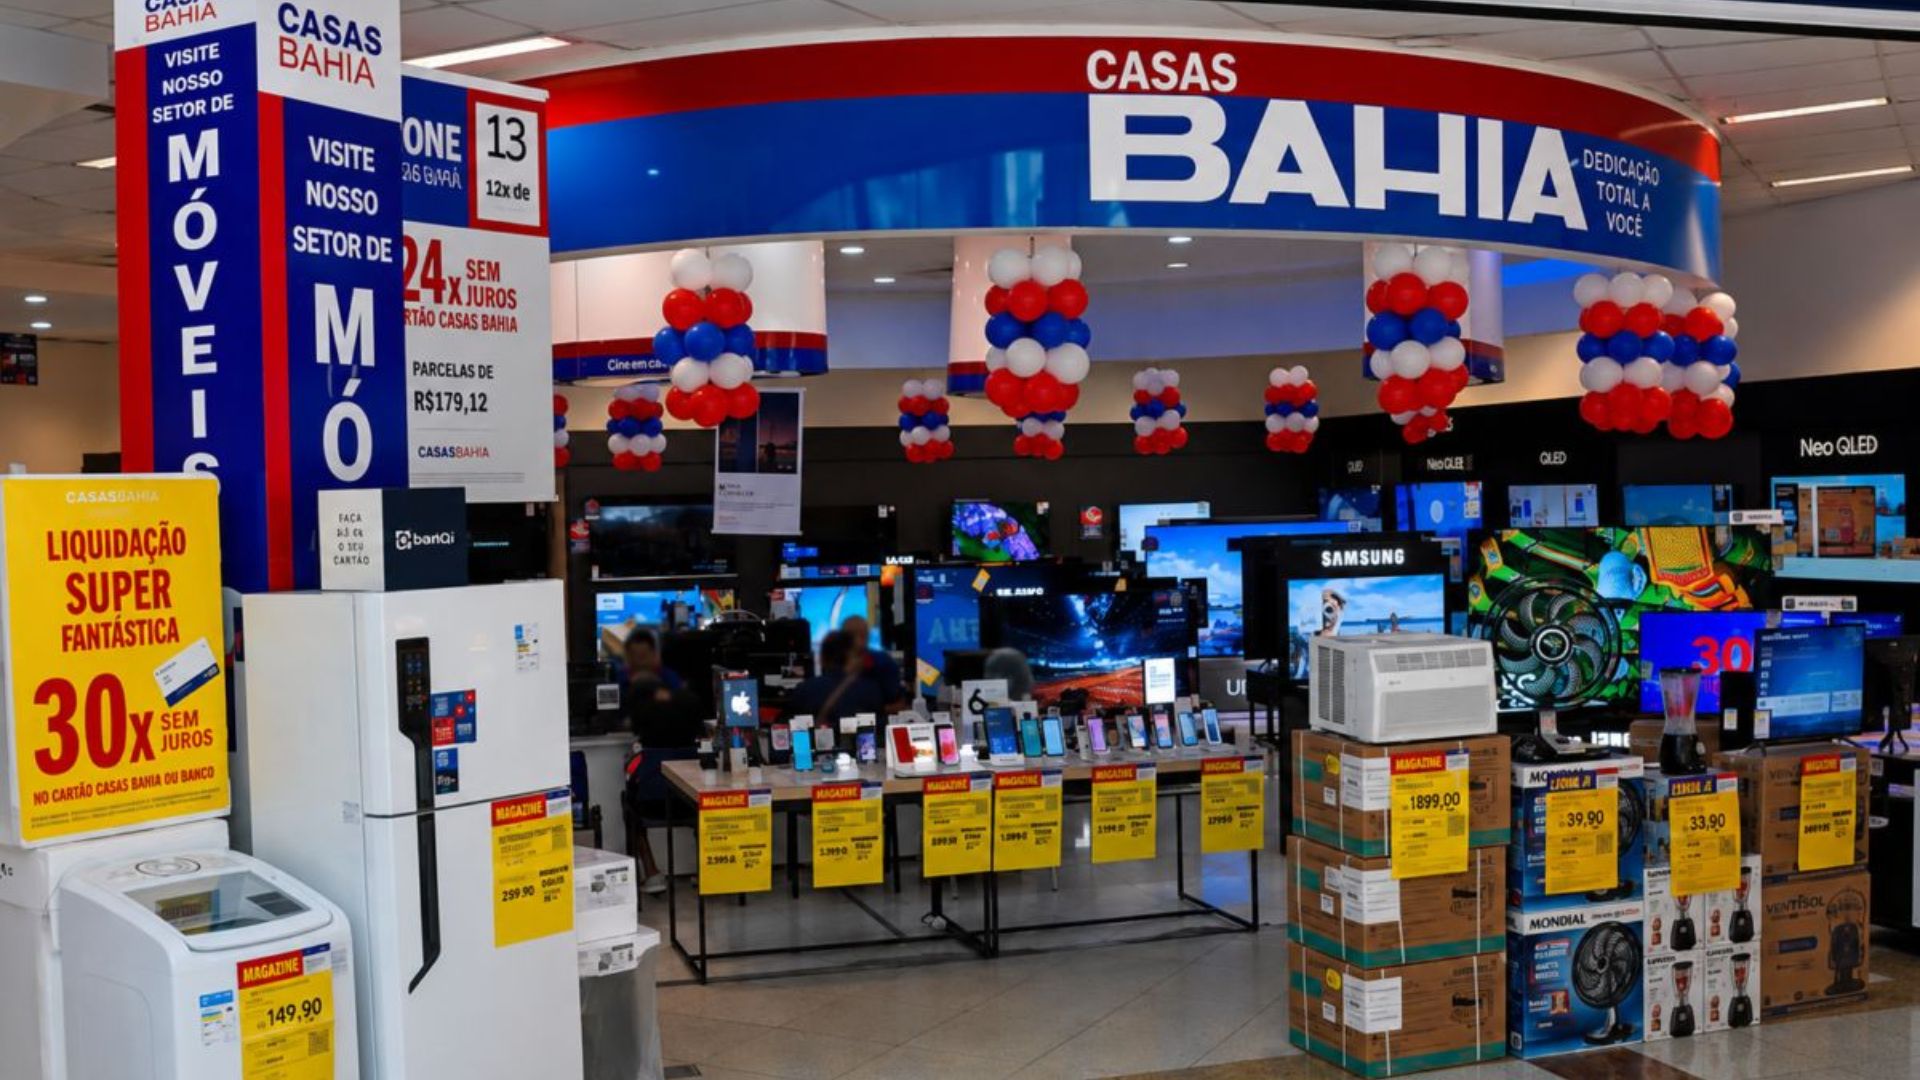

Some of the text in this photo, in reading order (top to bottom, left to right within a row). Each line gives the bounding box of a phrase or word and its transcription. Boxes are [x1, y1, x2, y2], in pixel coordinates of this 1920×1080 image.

[145, 2, 217, 32] BAHIA
[278, 2, 382, 56] CASAS
[164, 42, 220, 68] VISITE
[278, 35, 375, 89] BAHIA
[162, 69, 223, 96] NOSSO
[1086, 49, 1238, 93] CASAS
[152, 93, 234, 124] SETOR DE
[402, 116, 462, 162] ONE
[487, 113, 527, 163] 13
[307, 135, 376, 173] VISITE
[1088, 93, 1589, 231] BAHIA
[1583, 148, 1660, 187] DEDICAÇÃO
[305, 179, 379, 216] NOSSO
[486, 179, 531, 201] 12x de
[1596, 180, 1652, 213] TOTAL A
[293, 225, 394, 263] SETOR DE
[465, 258, 501, 283] SEM
[465, 284, 518, 310] JUROS
[439, 310, 479, 331] CASAS
[480, 313, 518, 333] BAHIA
[412, 361, 495, 379] PARCELAS DE
[413, 388, 489, 416] R$179,12
[1800, 435, 1878, 458] Neo QLED
[46, 519, 187, 566] LIQUIDAÇÃO
[412, 531, 456, 547] banQi
[1320, 548, 1405, 568] SAMSUNG
[65, 568, 172, 616] SUPER
[61, 613, 180, 653] FANTÁSTICA
[1690, 636, 1753, 677] 30
[160, 708, 200, 732] SEM
[160, 727, 214, 753] JUROS
[1394, 755, 1443, 772] MAGAZINE
[33, 765, 216, 807] NO CARTÃO CASAS BAHIA OU BANCO
[495, 800, 544, 822] MAGAZINE
[1566, 809, 1605, 829] 39,90
[1689, 812, 1726, 832] 33,90
[1529, 913, 1586, 931] MONDIAL
[242, 956, 300, 984] MAGAZINE
[266, 996, 323, 1028] 149,90
